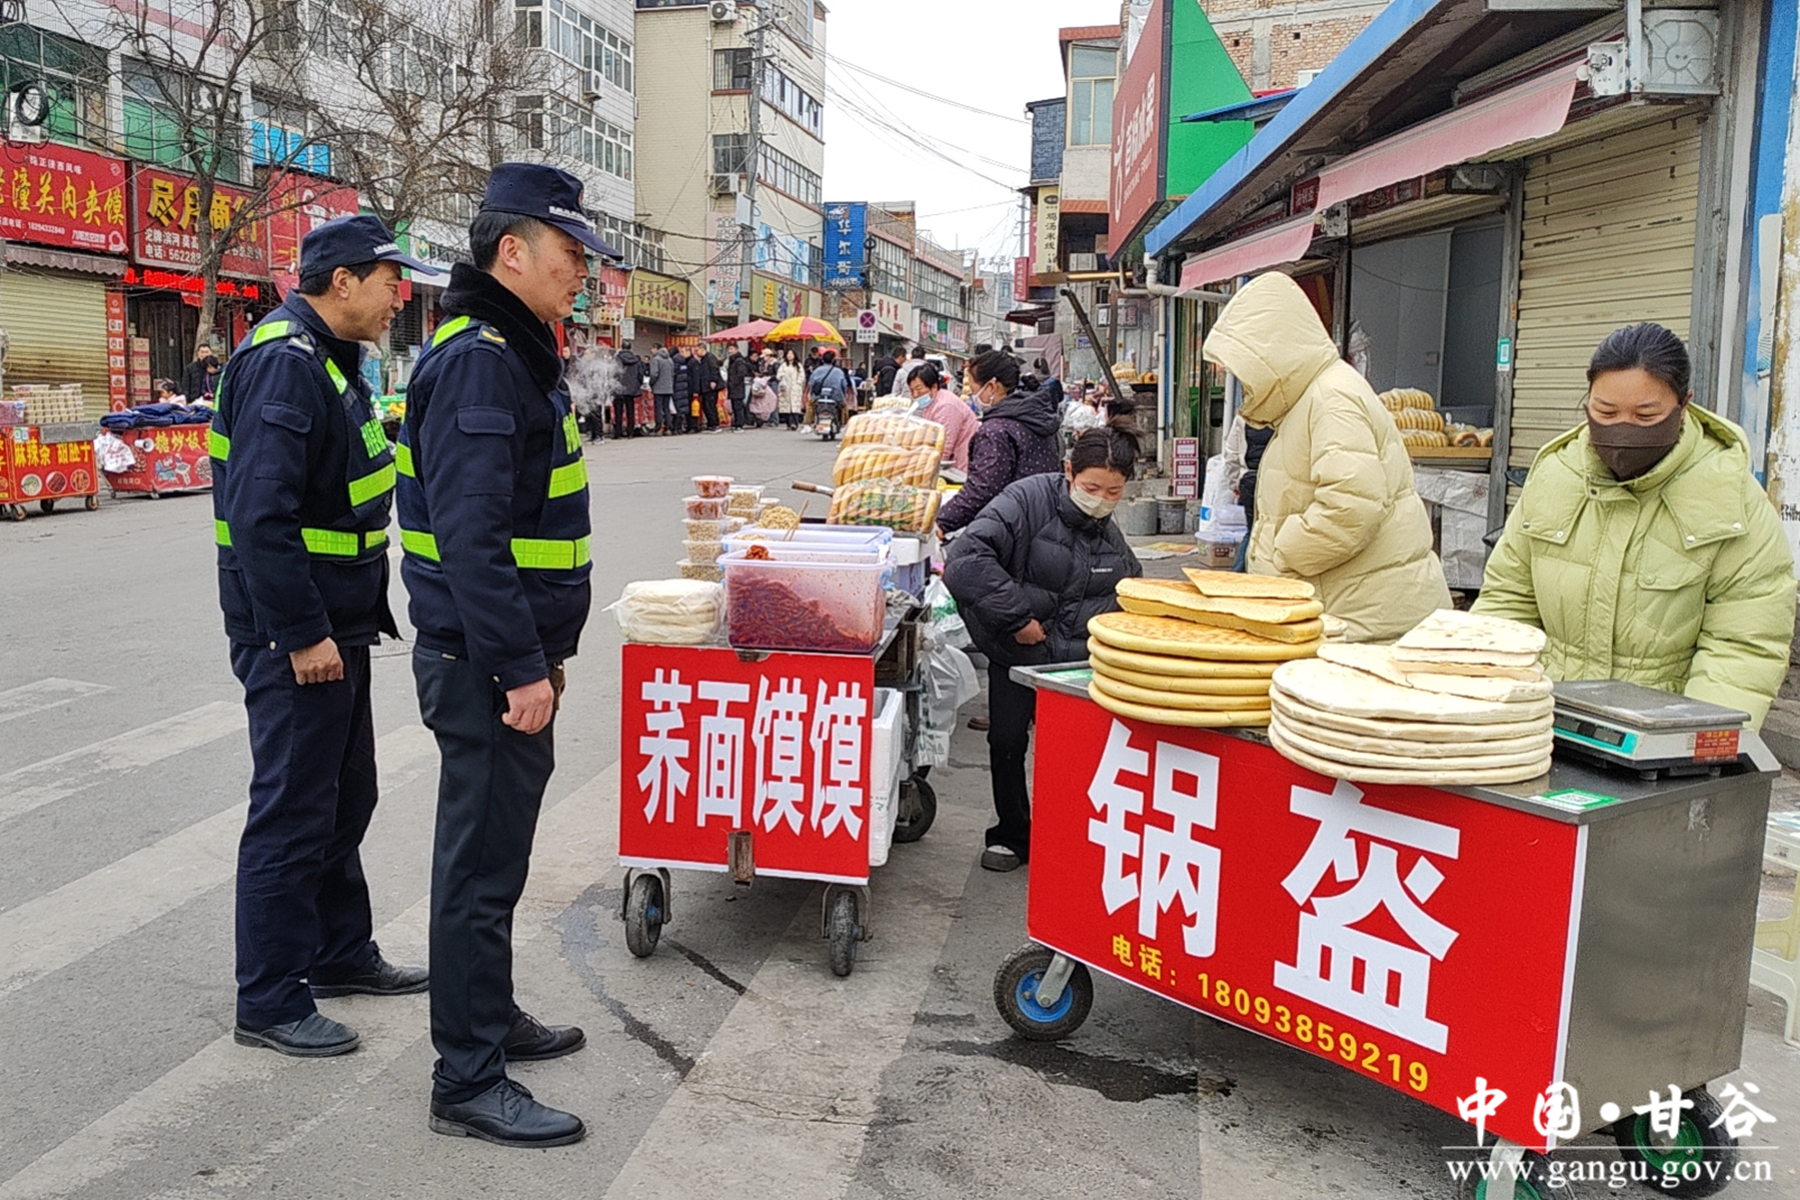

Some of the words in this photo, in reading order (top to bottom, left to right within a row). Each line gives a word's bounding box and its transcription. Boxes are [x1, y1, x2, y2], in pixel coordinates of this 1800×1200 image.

[1044, 213, 1057, 250] 鸡汤米线
[637, 668, 868, 841] 荞面馍馍
[1087, 717, 1461, 1055] 锅盔
